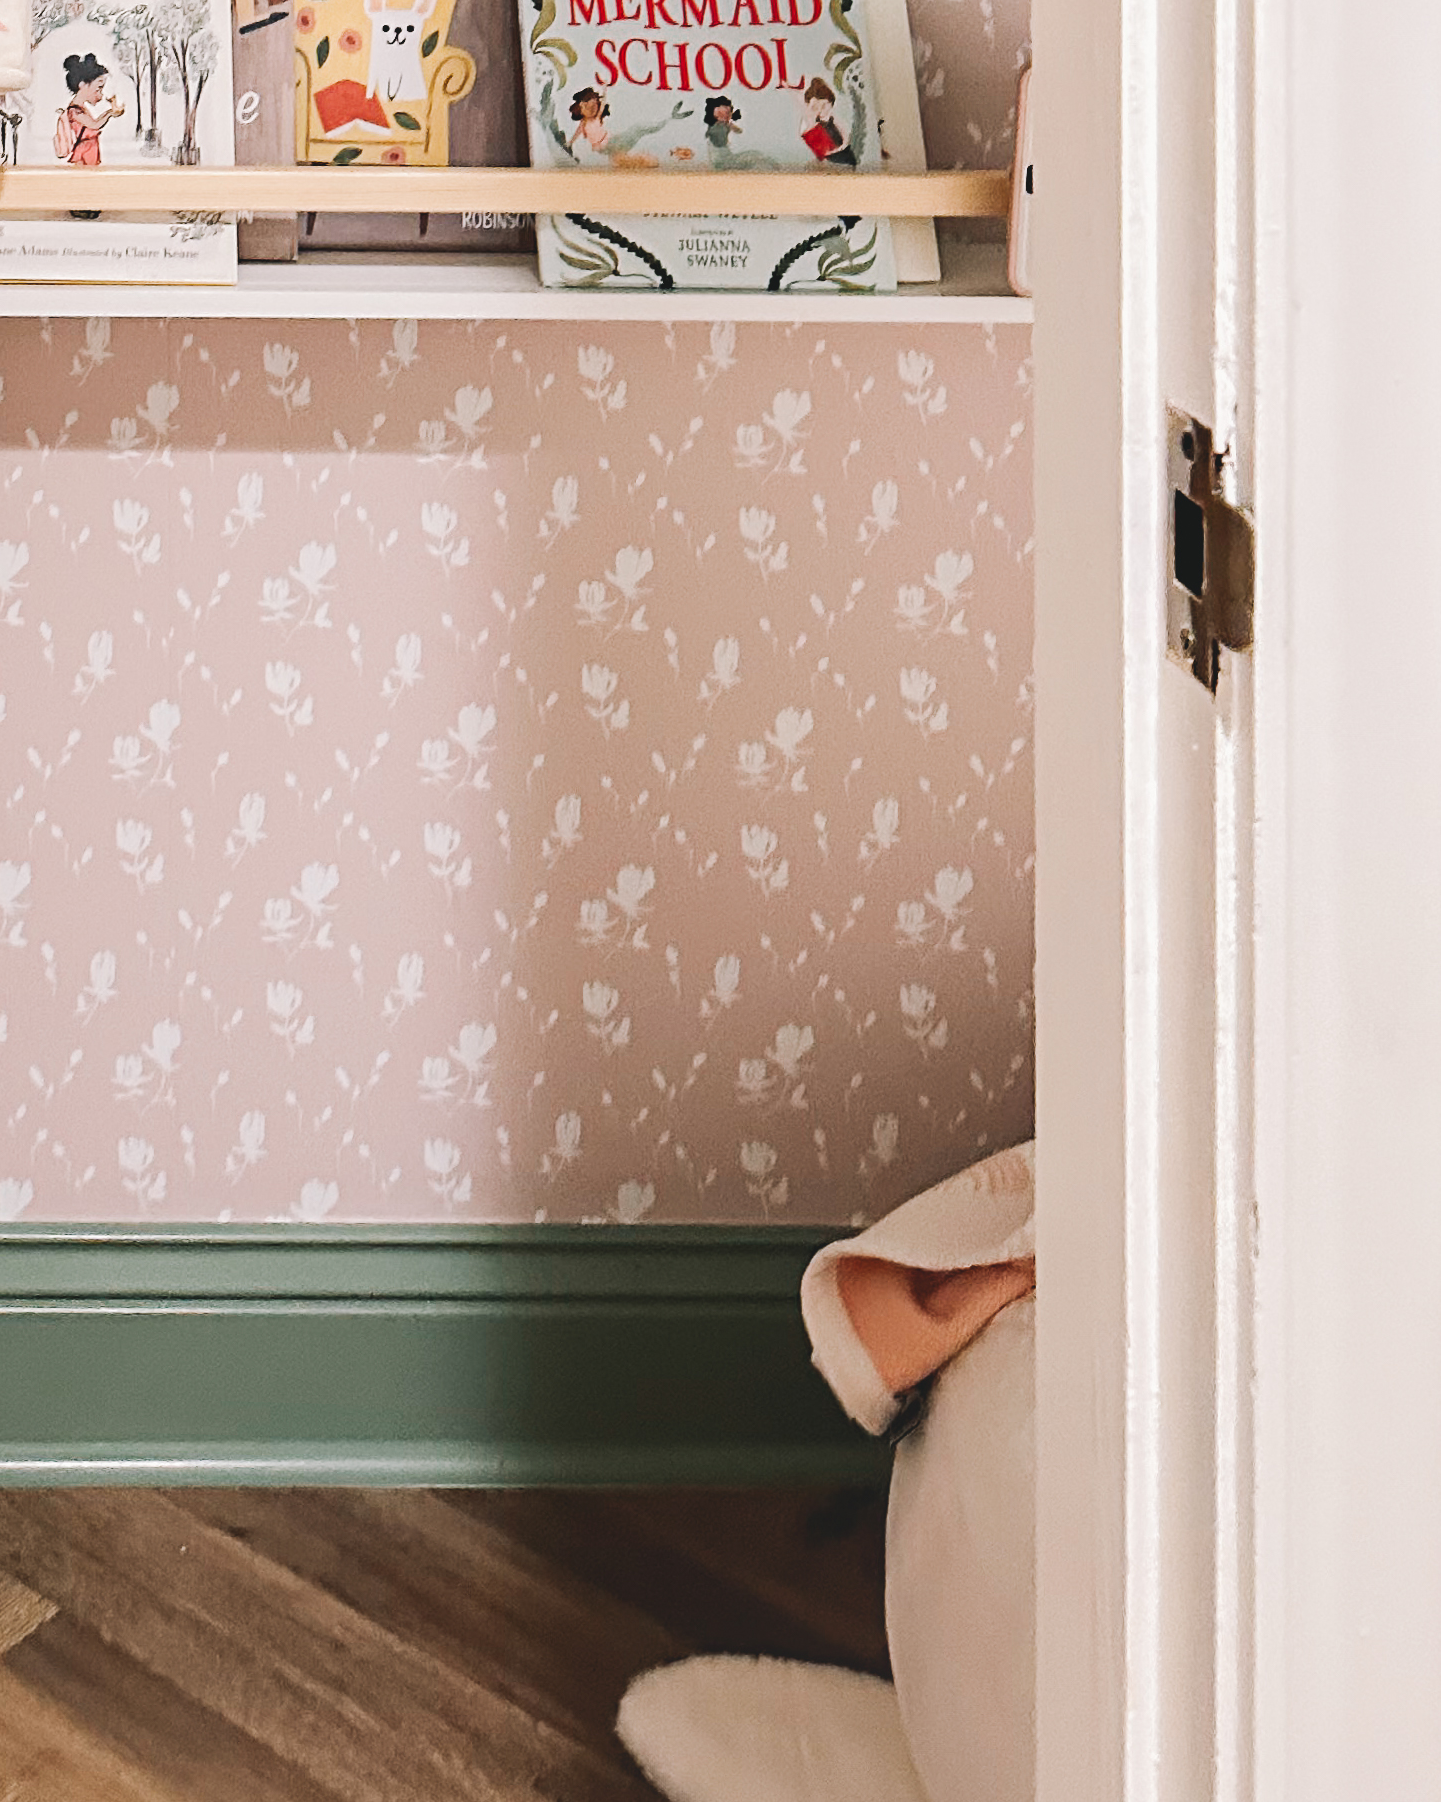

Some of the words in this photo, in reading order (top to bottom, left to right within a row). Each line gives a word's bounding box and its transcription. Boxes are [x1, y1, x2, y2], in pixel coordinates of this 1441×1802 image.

[594, 38, 807, 92] SCHOOL
[125, 245, 160, 258] Claire
[678, 238, 751, 252] JULIANNA
[686, 254, 748, 268] SWANEY
